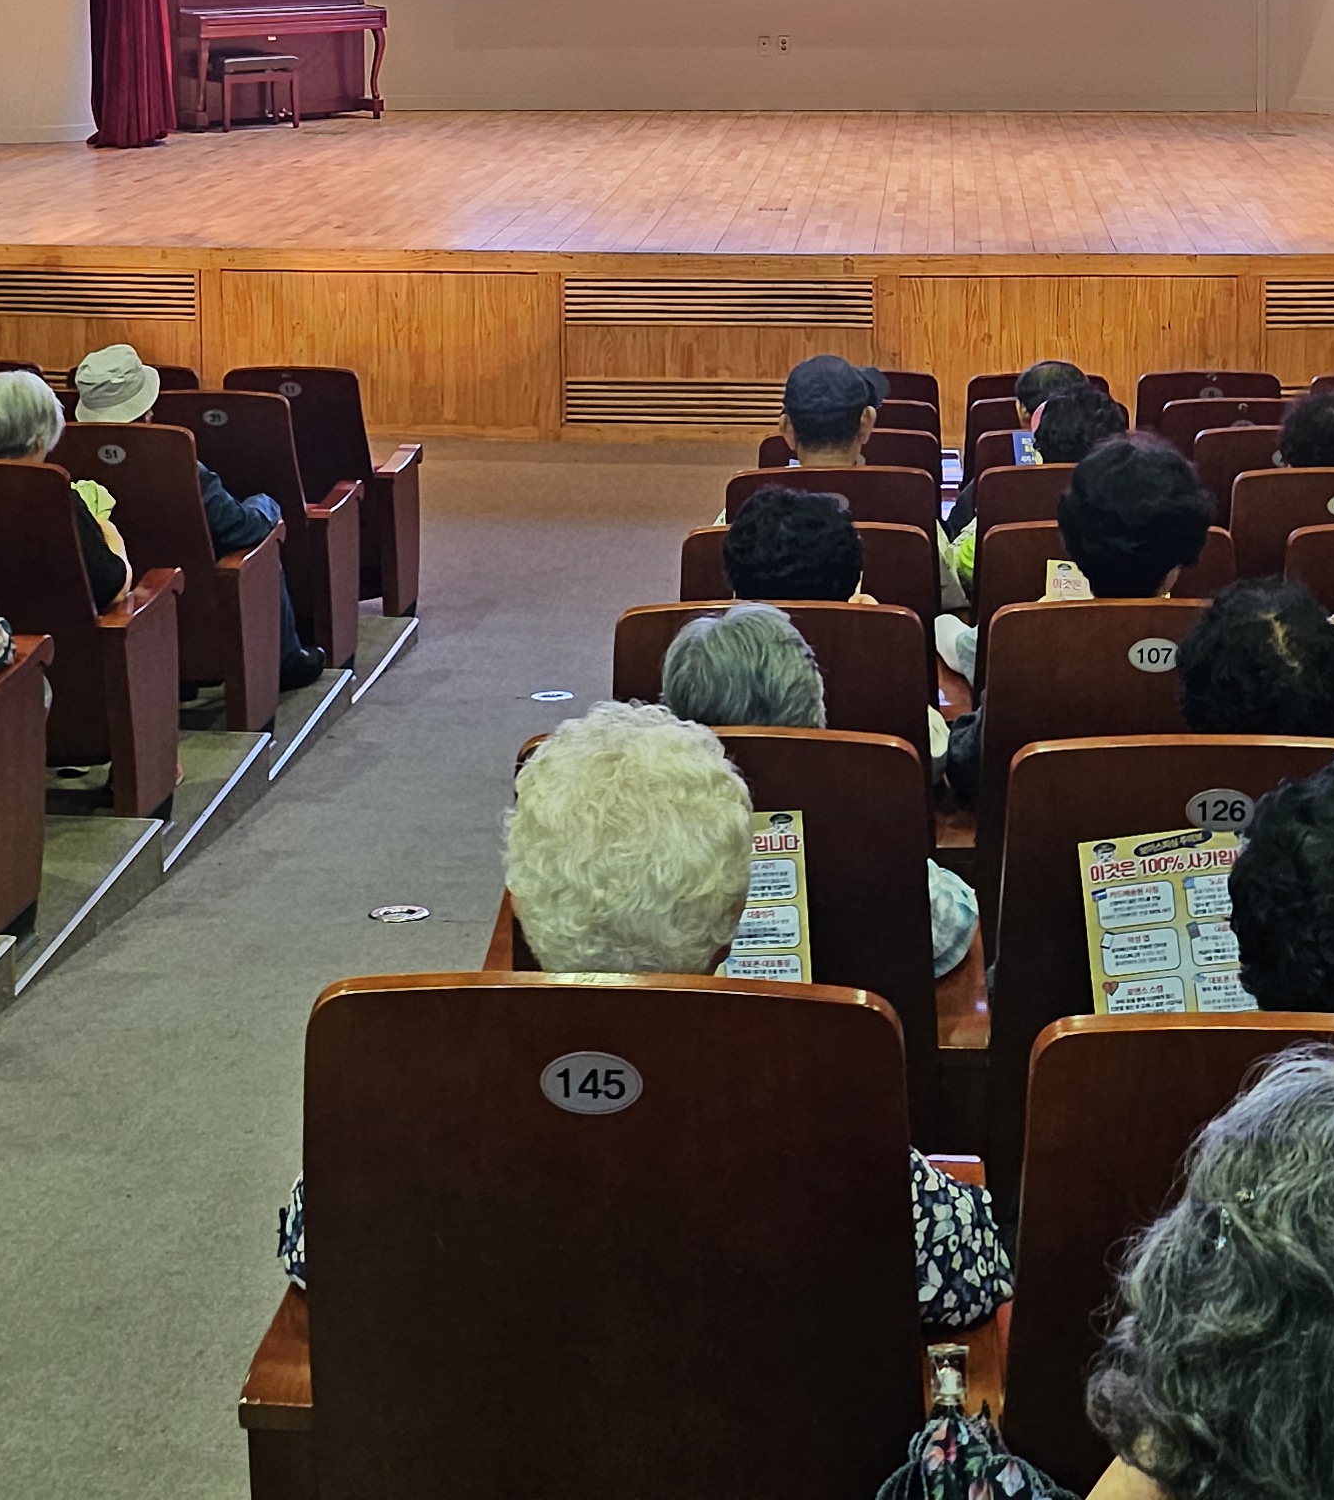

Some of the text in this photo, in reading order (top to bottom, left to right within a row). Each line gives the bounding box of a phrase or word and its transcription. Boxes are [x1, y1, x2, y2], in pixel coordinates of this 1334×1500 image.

[209, 411, 221, 422] 31
[104, 449, 118, 460] 51
[1136, 647, 1173, 665] 107
[1196, 799, 1247, 823] 126
[752, 834, 800, 851] 입니다
[1090, 850, 1238, 881] 이것은 100% 사기입
[557, 1067, 626, 1099] 145
